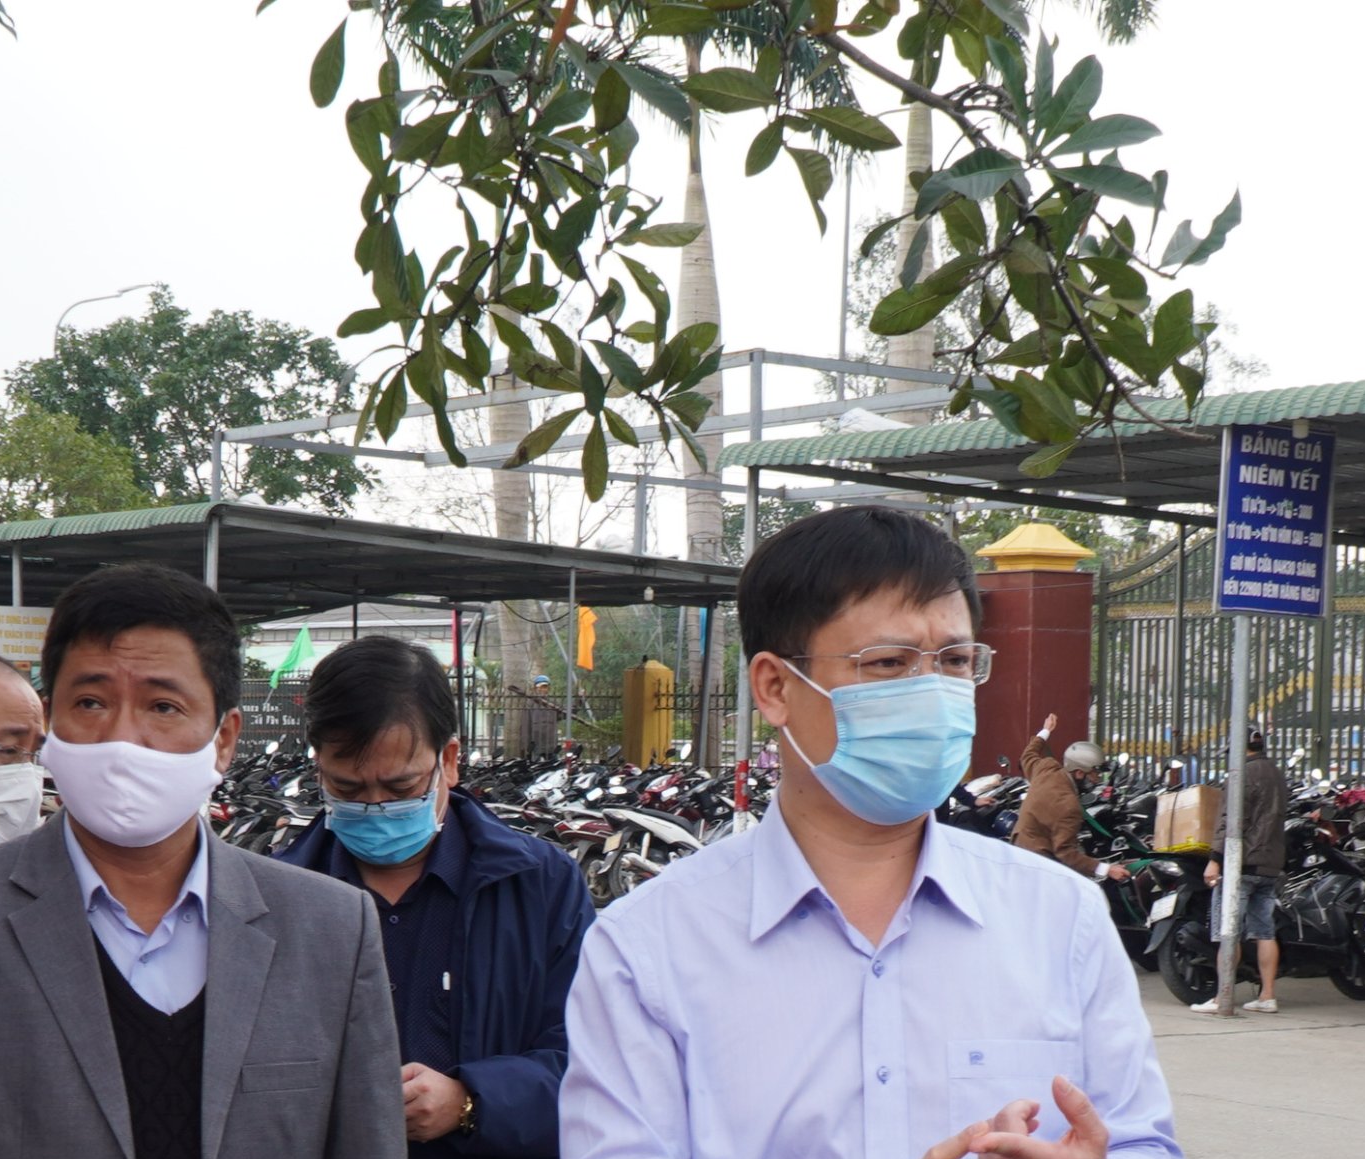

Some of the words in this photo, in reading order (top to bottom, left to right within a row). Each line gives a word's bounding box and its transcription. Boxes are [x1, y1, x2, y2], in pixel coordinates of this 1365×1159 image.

[1240, 431, 1291, 458] BẢNG
[1294, 441, 1322, 462] GIÁ
[1238, 463, 1285, 487] NIÊM
[1290, 467, 1321, 491] YẾT
